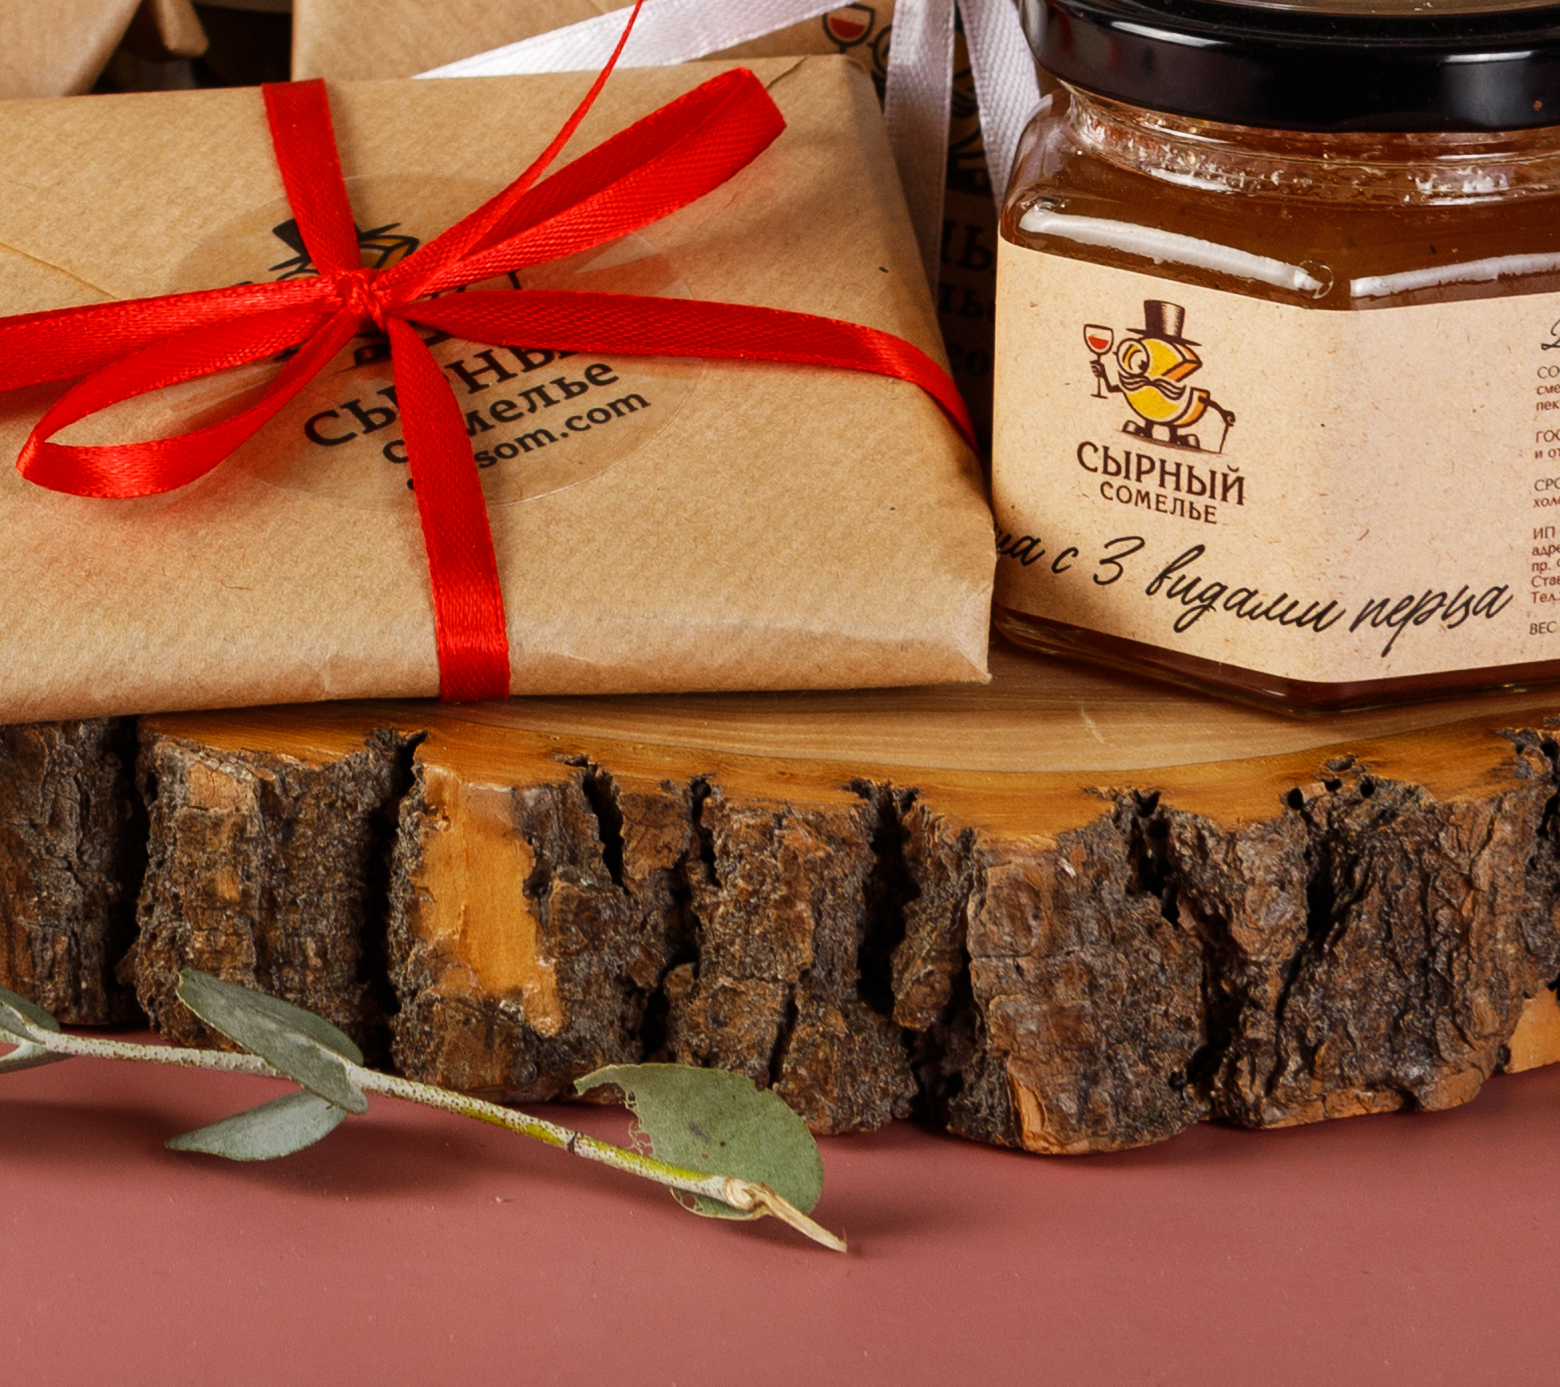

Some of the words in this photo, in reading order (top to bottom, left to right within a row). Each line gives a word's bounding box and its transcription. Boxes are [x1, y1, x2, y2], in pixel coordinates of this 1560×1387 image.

[1533, 449, 1544, 460] и
[1075, 439, 1247, 507] СЫРНЫЙ
[1098, 480, 1219, 526] СОМЕЛЬЕ
[1532, 525, 1557, 541] ИП
[1530, 560, 1552, 574] пр.
[1051, 547, 1080, 575] с
[1091, 535, 1146, 586] 3
[1145, 544, 1349, 634] видами
[1348, 582, 1515, 658] перца
[1528, 619, 1558, 636] ВЕС
